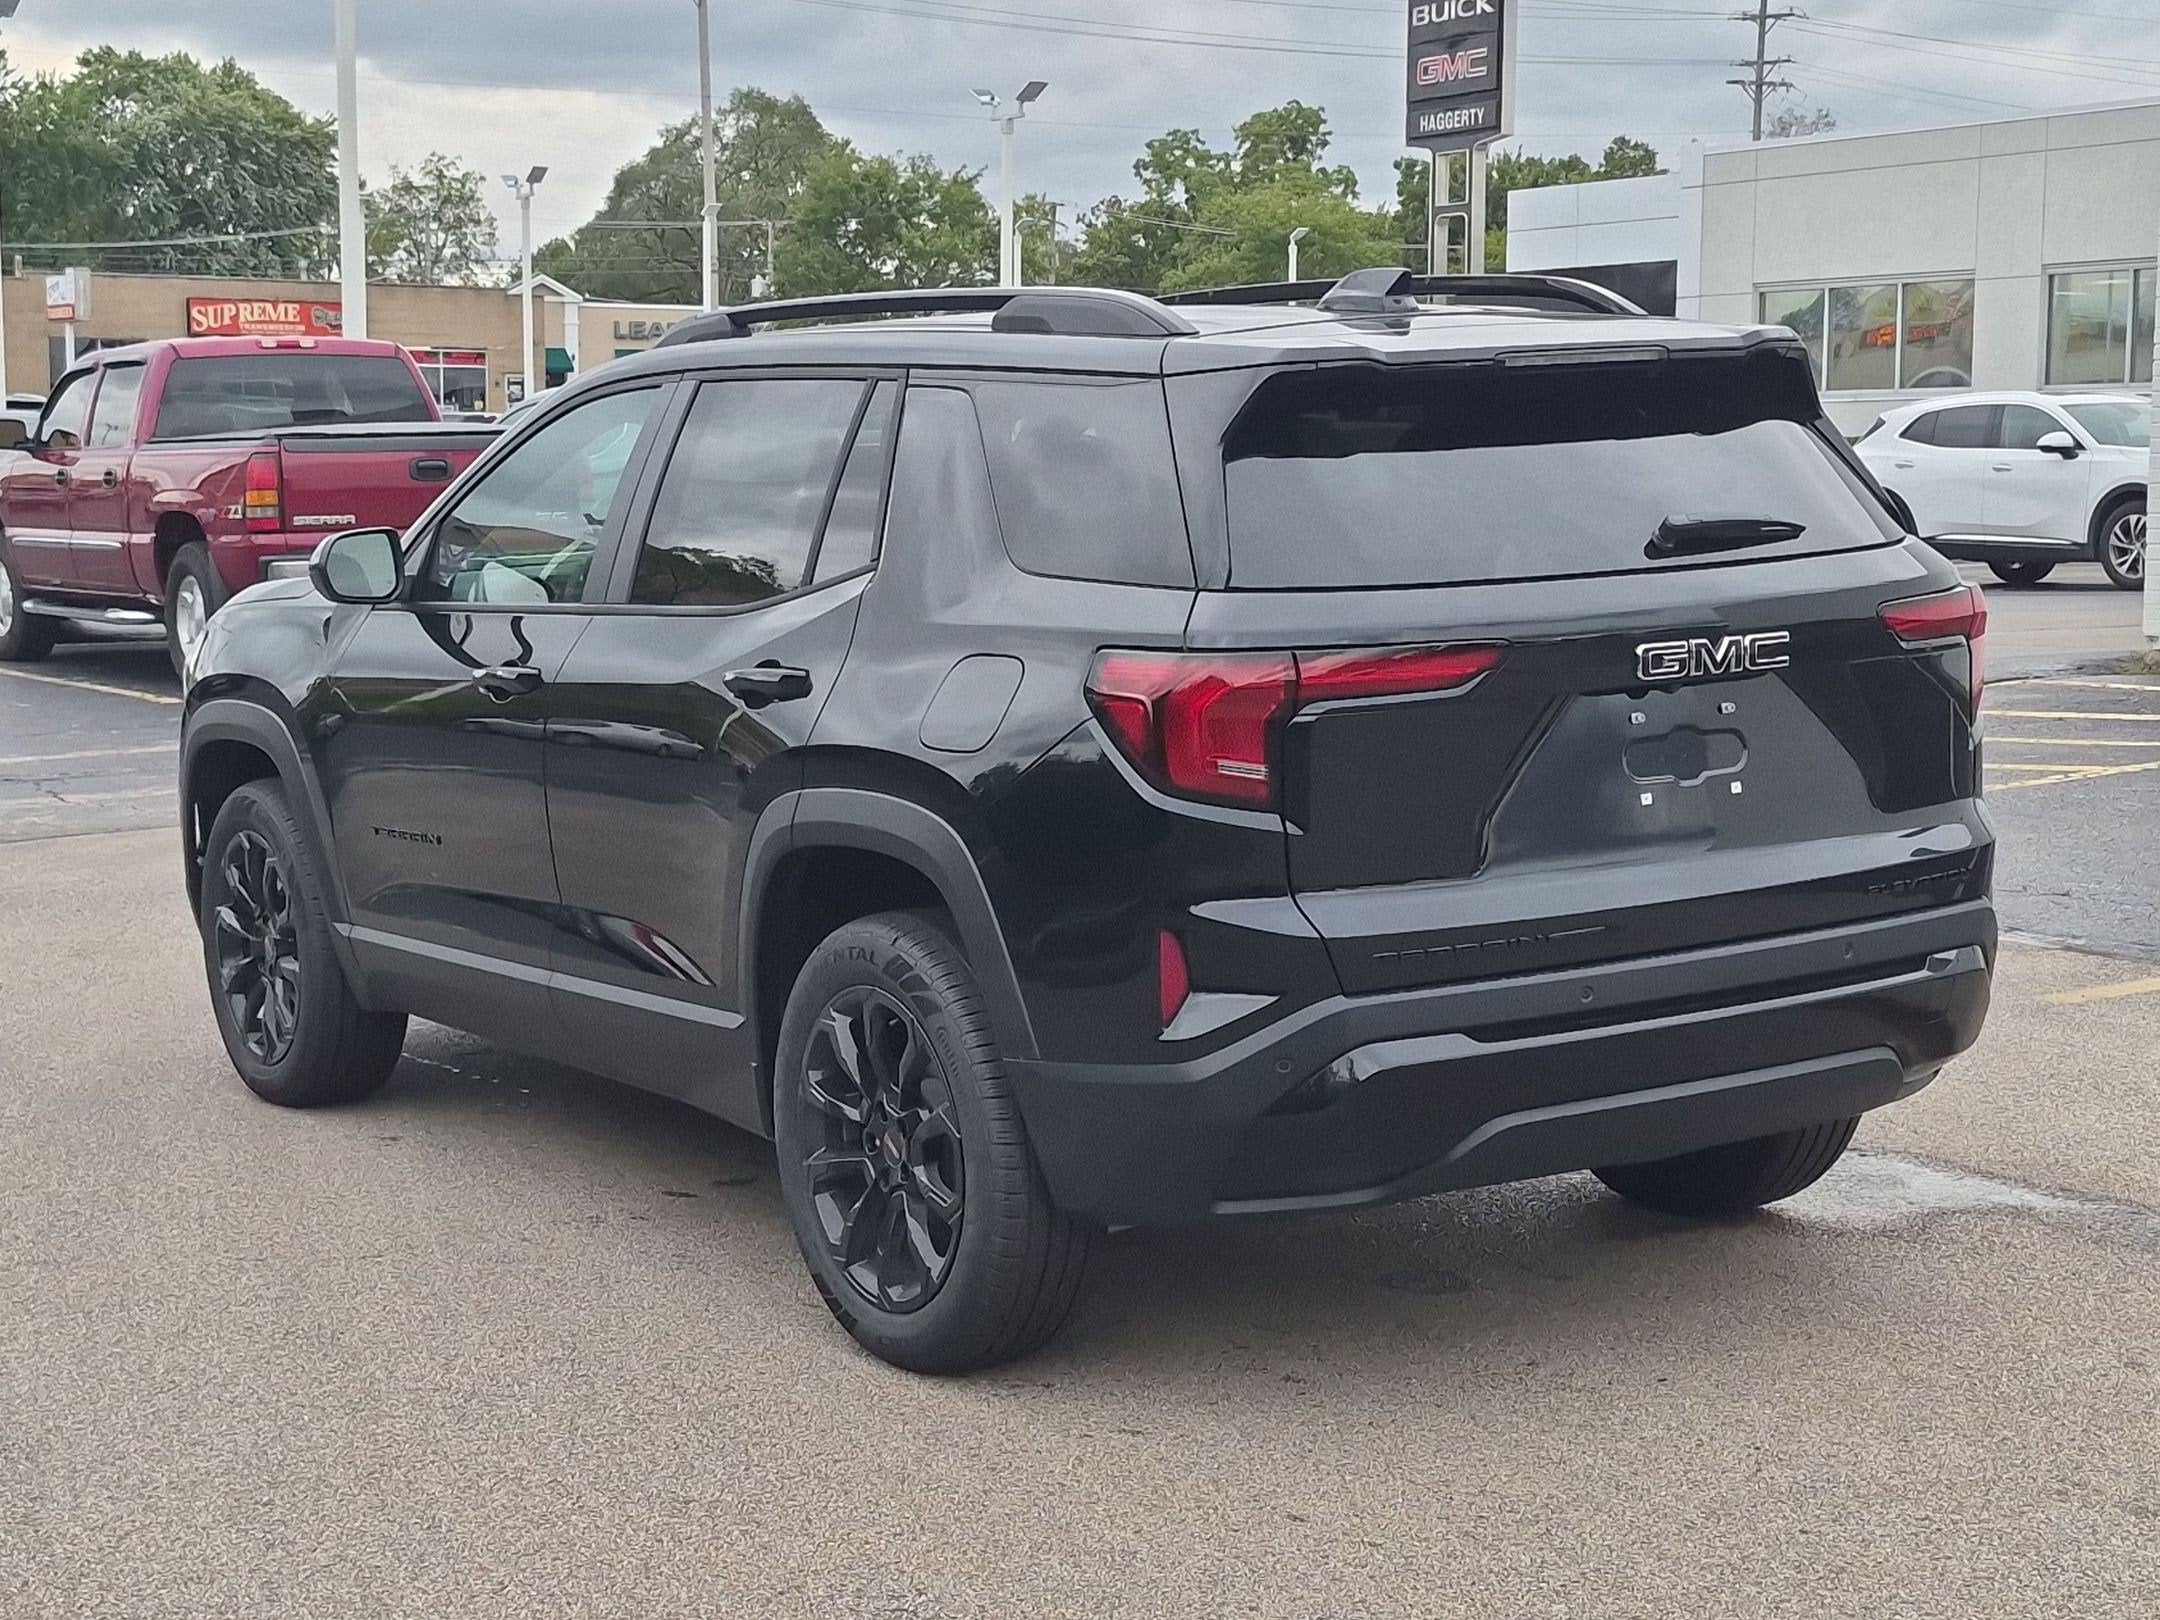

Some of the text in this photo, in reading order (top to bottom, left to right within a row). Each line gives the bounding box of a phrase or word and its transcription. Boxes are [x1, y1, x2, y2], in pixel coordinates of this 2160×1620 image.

[1412, 0, 1496, 27] BUICK
[1417, 47, 1488, 85] GMC
[1420, 107, 1485, 132] HAGGERTY
[191, 301, 300, 332] SUPREME
[1634, 631, 1790, 681] GMC
